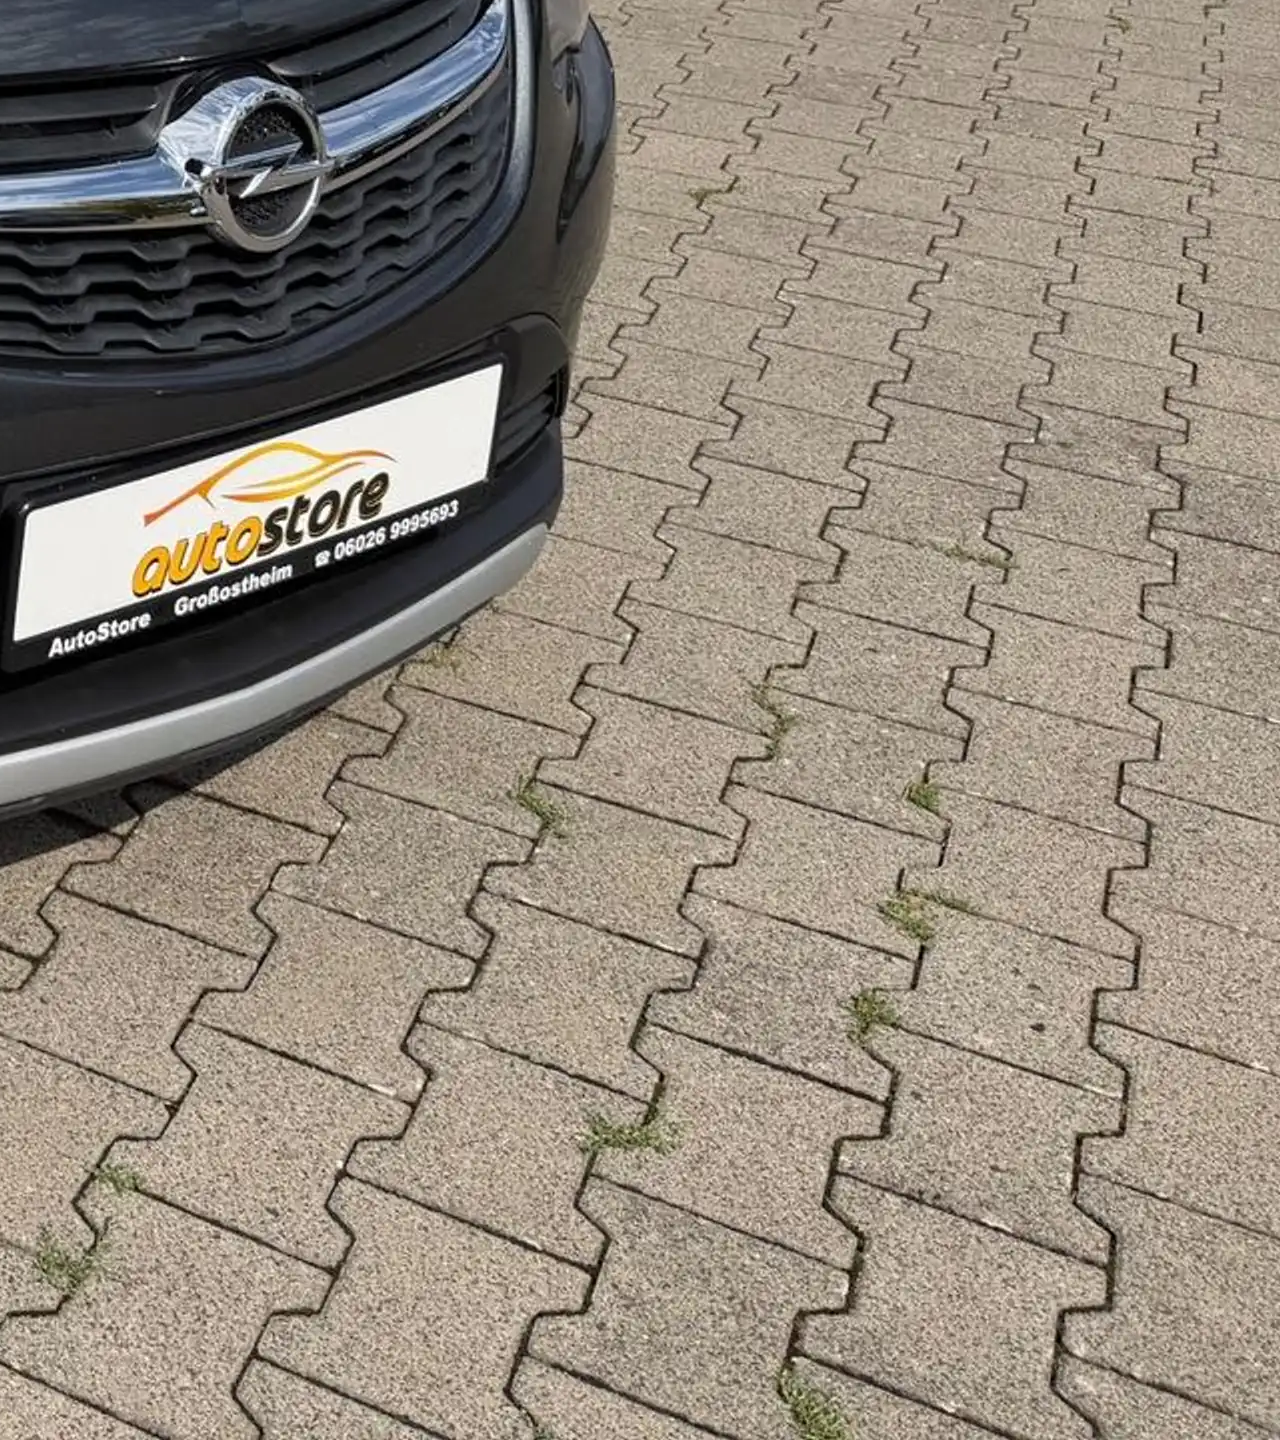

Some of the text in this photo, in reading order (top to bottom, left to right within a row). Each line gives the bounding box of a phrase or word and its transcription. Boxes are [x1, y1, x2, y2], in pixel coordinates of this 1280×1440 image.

[48, 499, 460, 658] AutoStore Großostheim 06026 9995693
[132, 471, 390, 597] autostore
